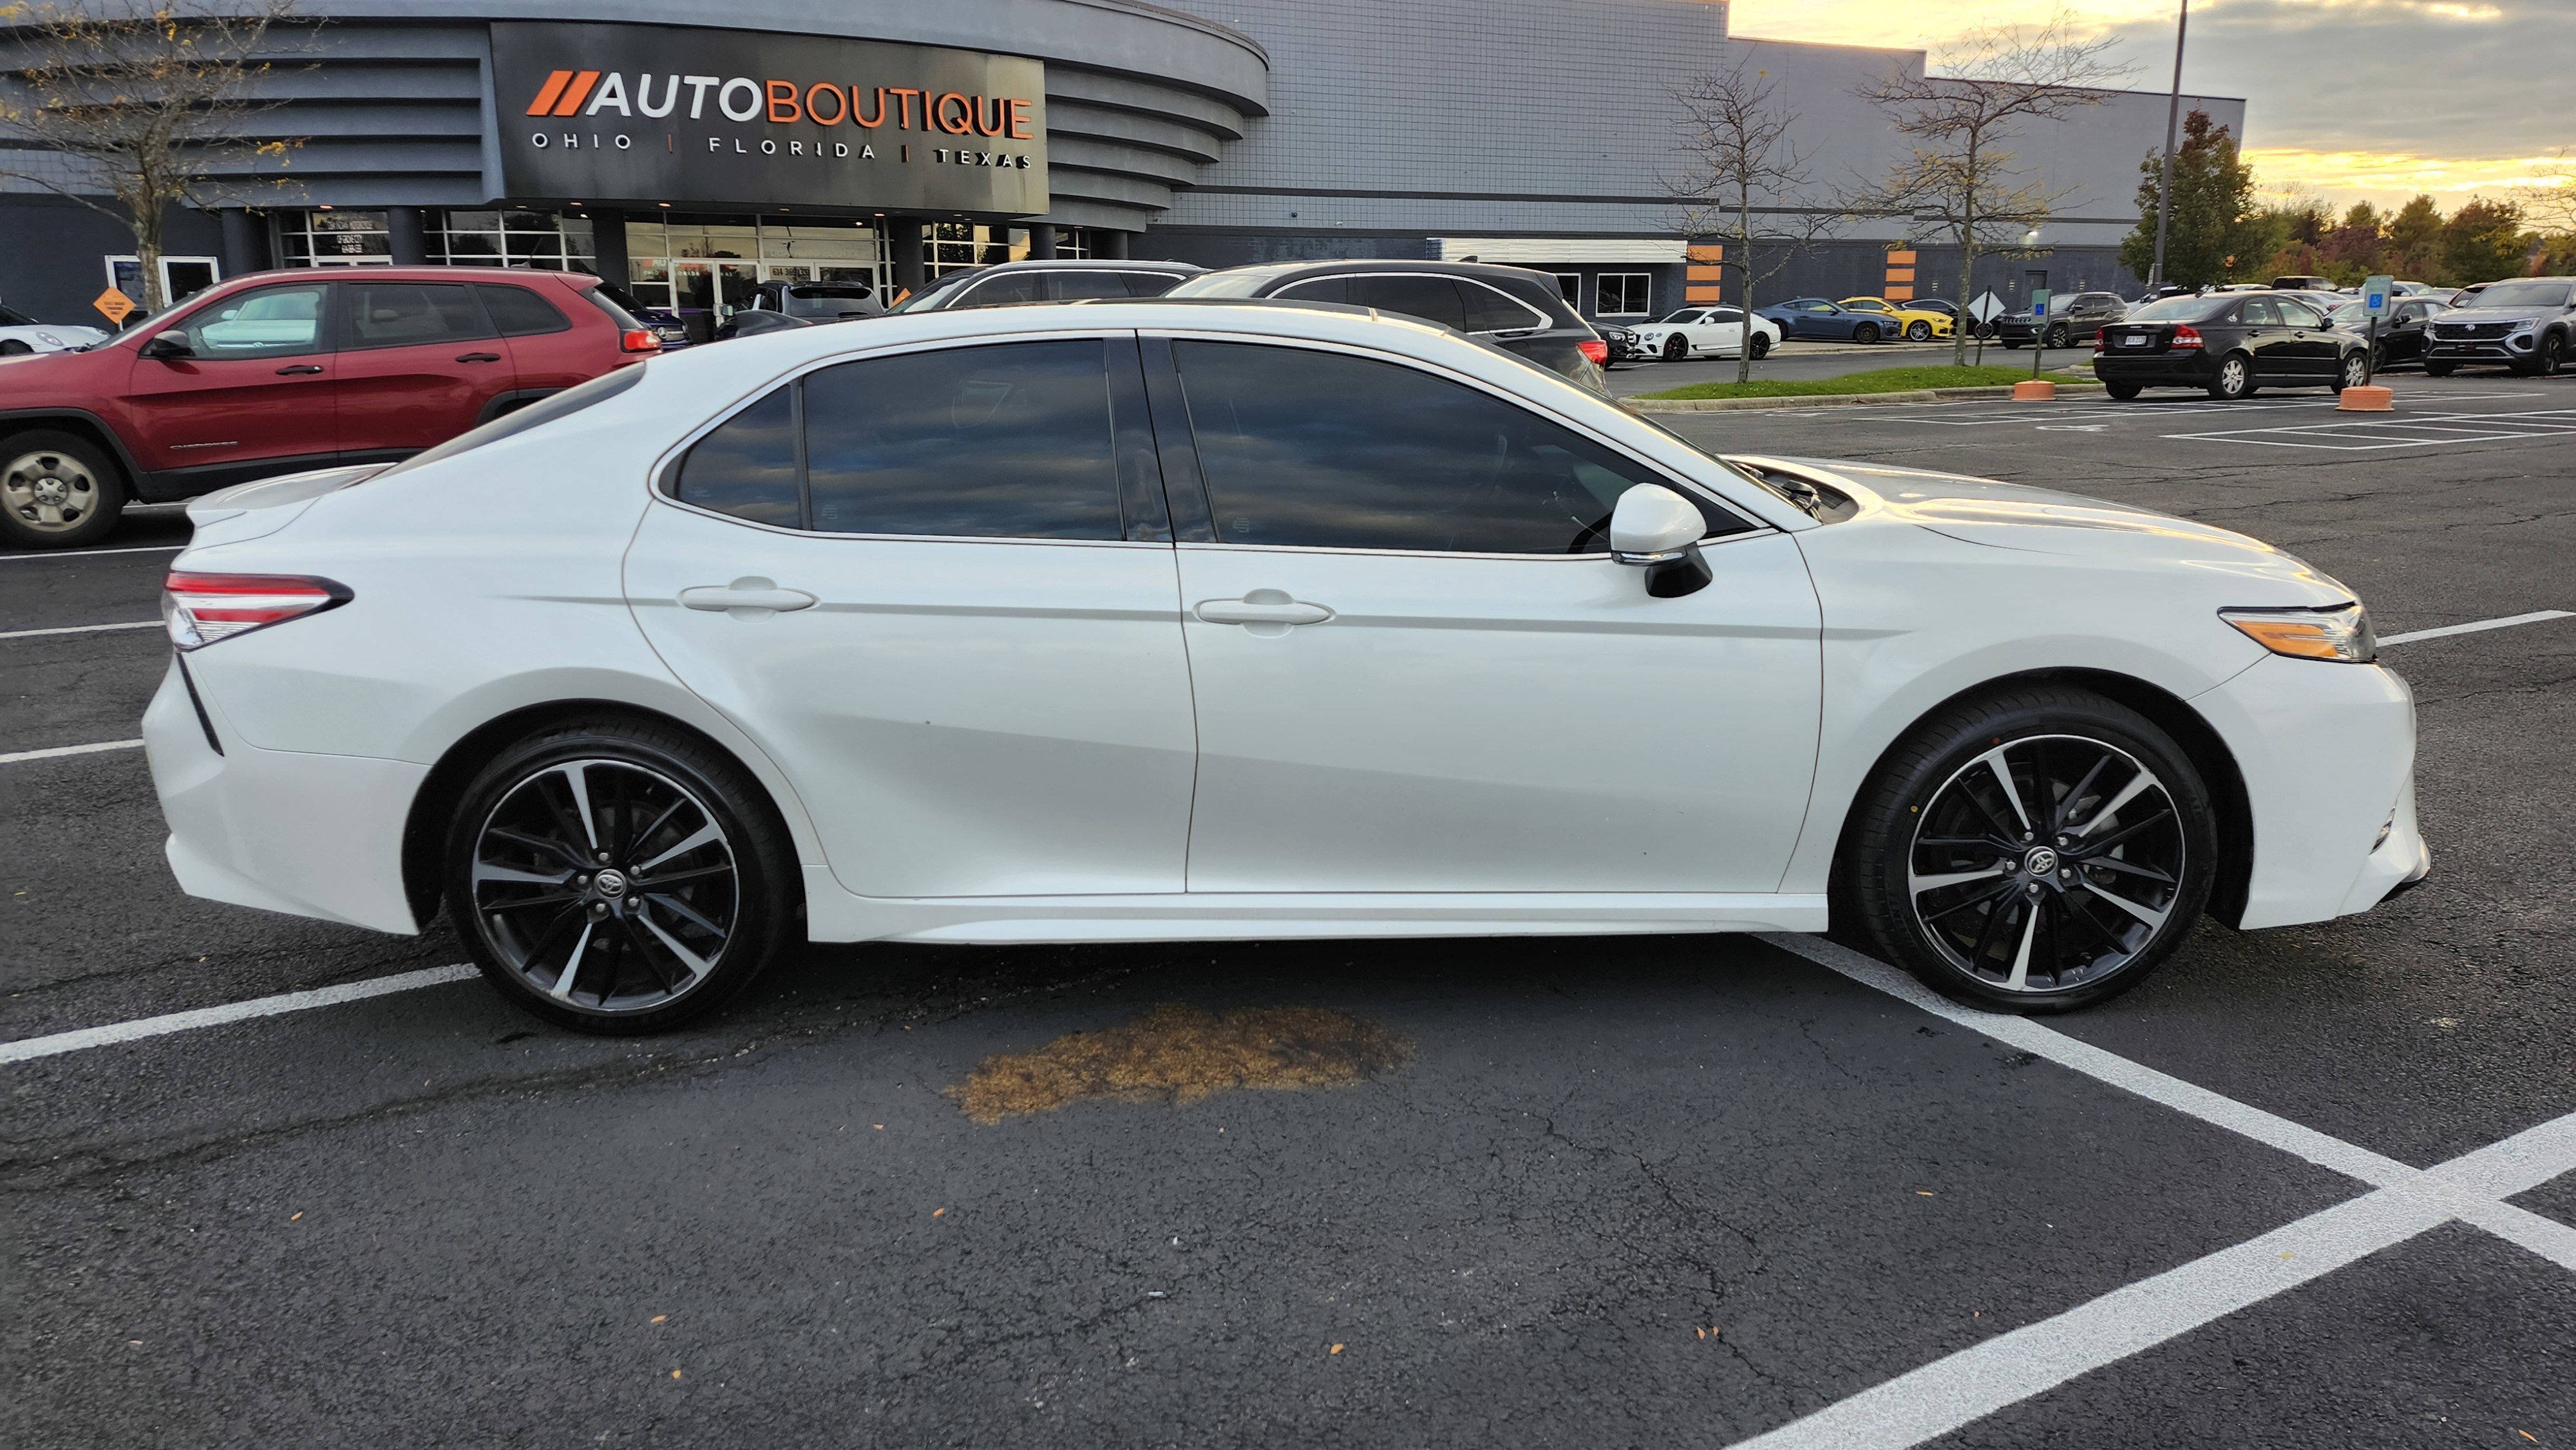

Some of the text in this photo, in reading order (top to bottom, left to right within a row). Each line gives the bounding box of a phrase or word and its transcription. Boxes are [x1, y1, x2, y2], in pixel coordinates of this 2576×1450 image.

[532, 133, 1031, 169] OHIO FLORIDA TEXAS
